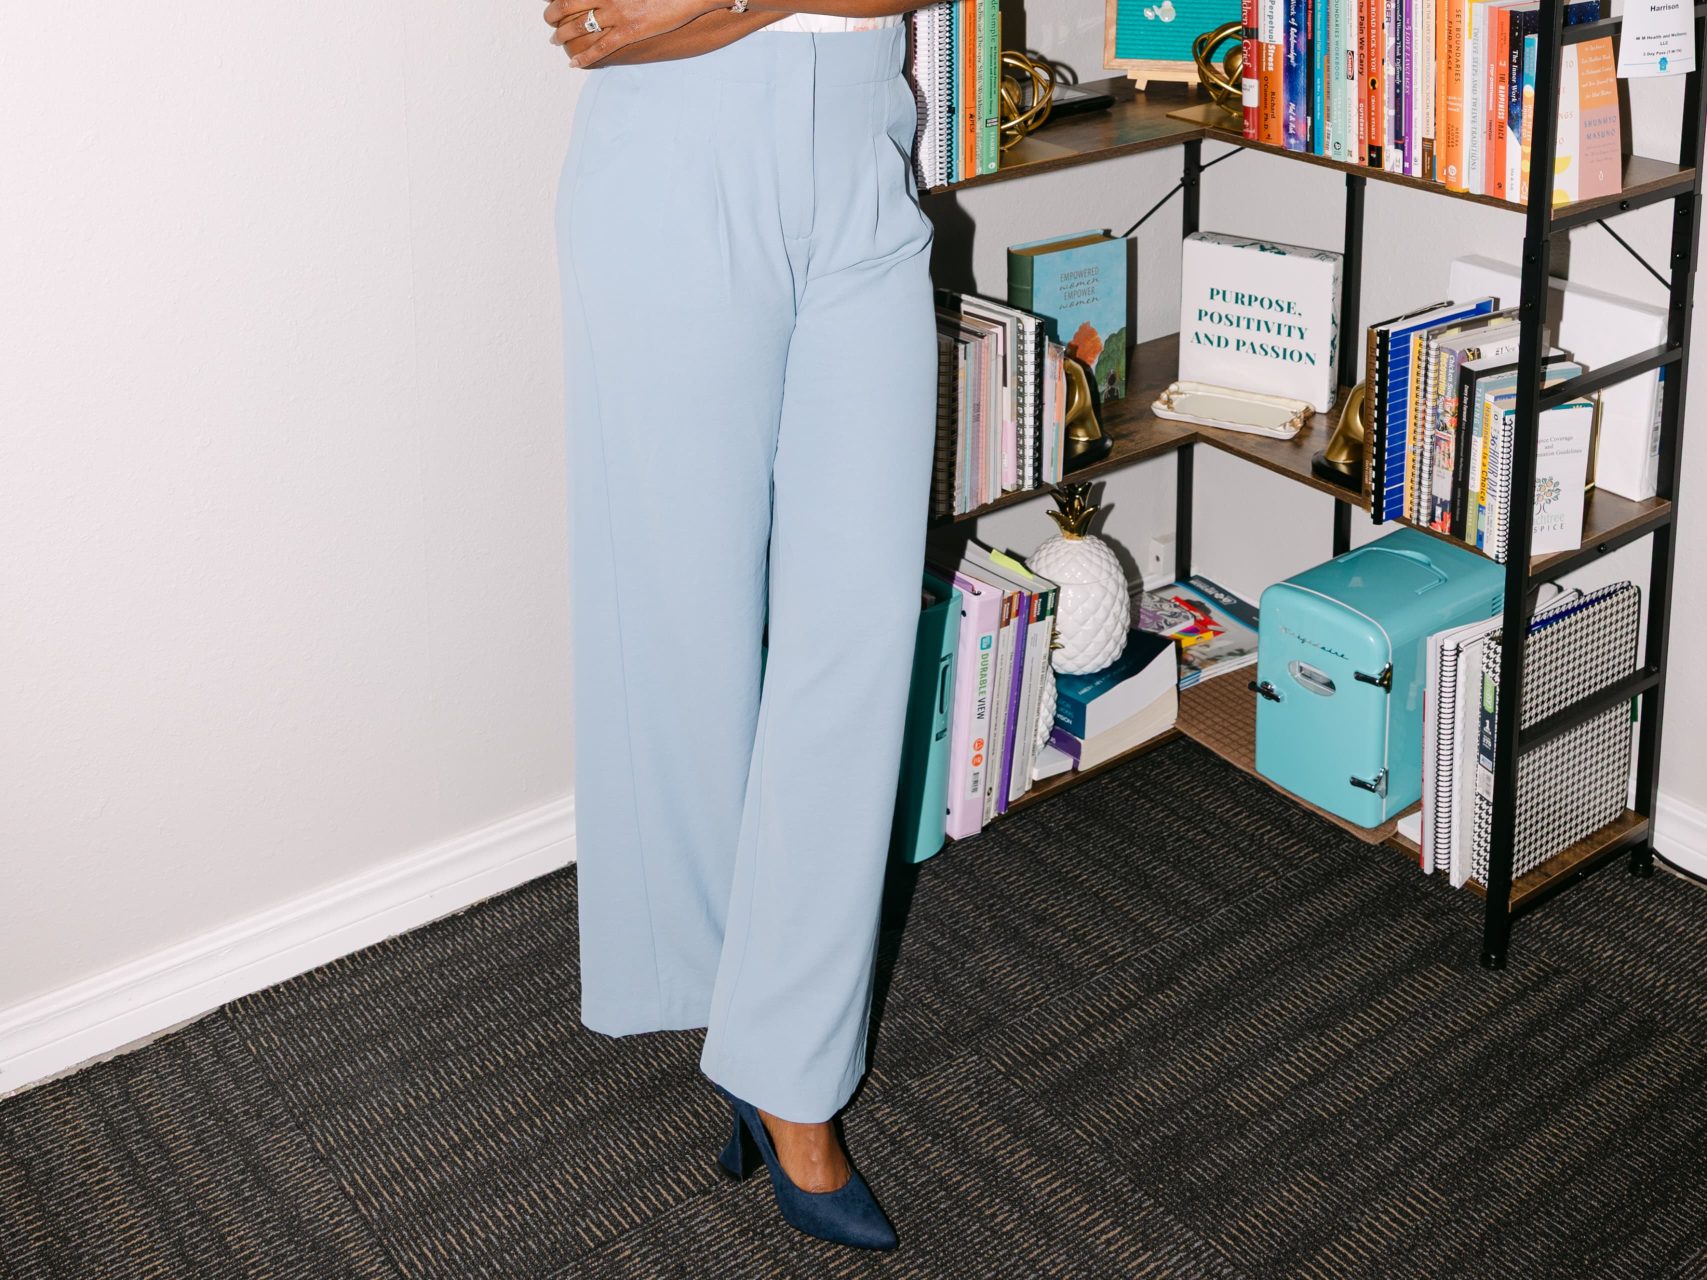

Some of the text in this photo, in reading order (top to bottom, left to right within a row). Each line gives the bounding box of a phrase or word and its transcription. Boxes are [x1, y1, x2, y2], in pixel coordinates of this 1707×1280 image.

[1267, 0, 1277, 43] Perpetual
[1650, 3, 1679, 12] Harrison
[989, 13, 998, 43] simple
[1289, 18, 1297, 26] of
[1242, 39, 1252, 68] Grief
[1267, 44, 1276, 71] Stress
[1288, 26, 1298, 64] Relationships
[1359, 37, 1365, 51] We
[1584, 115, 1616, 128] SHUNMYO
[1586, 129, 1616, 140] MASUNO
[1059, 278, 1100, 290] women
[1060, 266, 1099, 282] EMPOWERED
[1059, 297, 1100, 310] women
[1064, 287, 1095, 300] EMPOWER
[1198, 308, 1308, 340] POSITIVITY
[1190, 331, 1316, 366] AND PASSION
[1368, 346, 1376, 393] BEFORE
[1438, 351, 1447, 395] Recovering
[1447, 354, 1455, 381] Chicken
[1470, 387, 1482, 489] TALKING ALZHEIMER'S
[1483, 406, 1491, 450] Happiness
[1487, 433, 1499, 478] 36-HOUR
[1487, 480, 1496, 500] DAY
[1533, 523, 1564, 533] SPICE
[1280, 626, 1349, 660] Frigidaire
[976, 653, 990, 720] DURABLE VIEW
